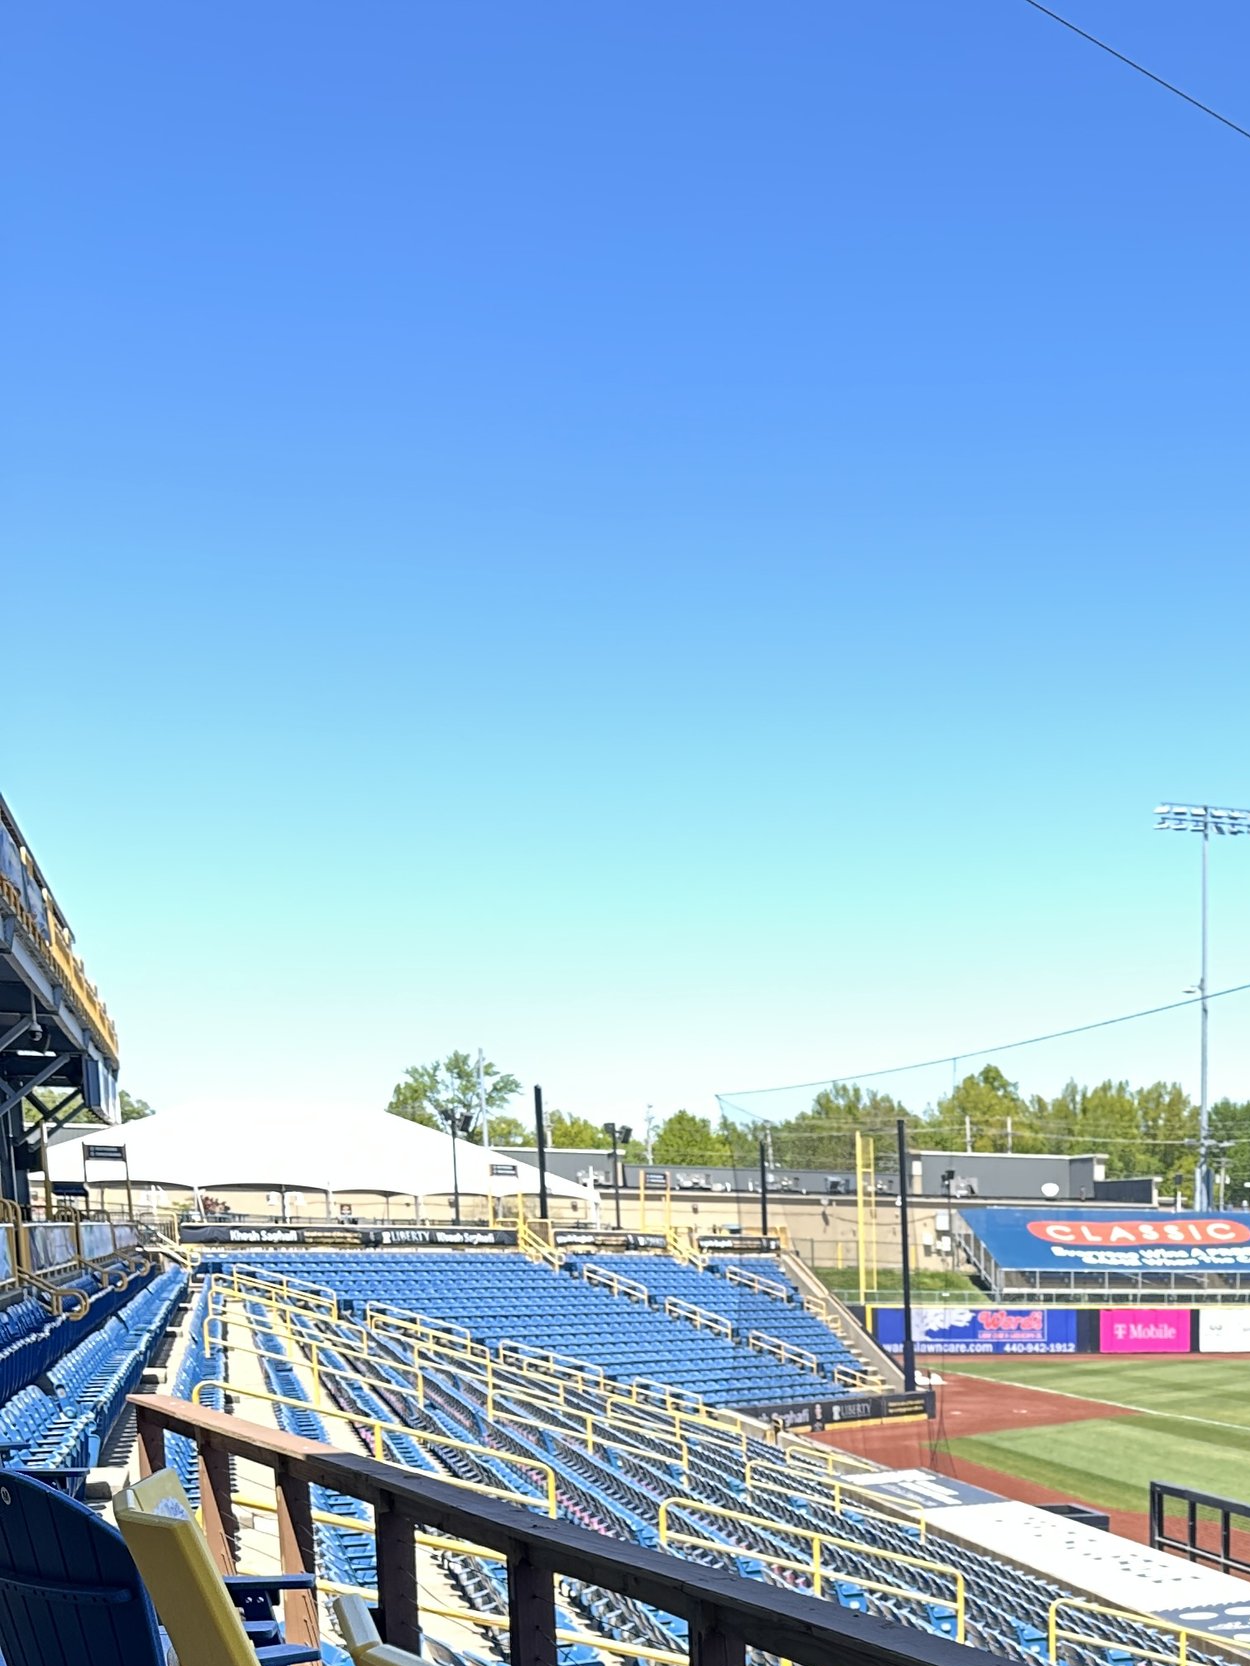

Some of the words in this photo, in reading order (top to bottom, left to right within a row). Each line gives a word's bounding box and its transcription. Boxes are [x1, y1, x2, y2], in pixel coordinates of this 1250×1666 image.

[391, 1231, 430, 1242] LIBERTY
[1045, 1222, 1236, 1242] CLASSIC
[1003, 1342, 1076, 1353] 440-942-1912
[840, 1402, 871, 1417] LIBERTY
